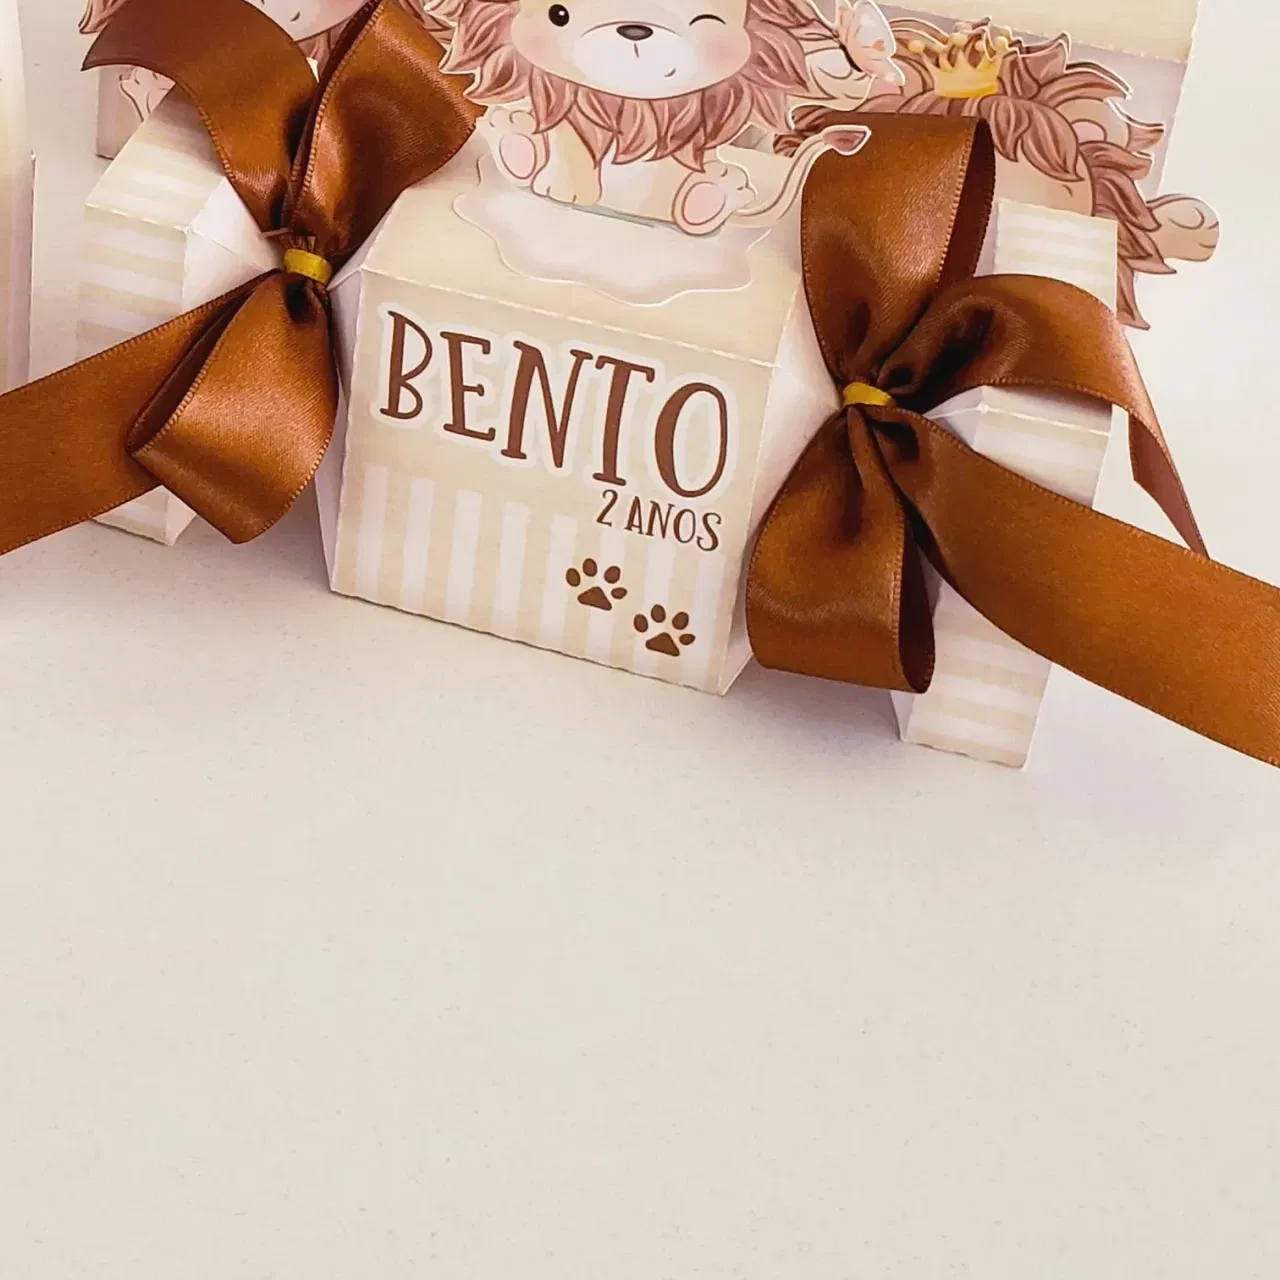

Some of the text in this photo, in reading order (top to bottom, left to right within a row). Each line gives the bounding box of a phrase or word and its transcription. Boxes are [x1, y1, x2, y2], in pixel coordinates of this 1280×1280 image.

[379, 310, 728, 498] BENTO
[595, 489, 723, 553] 2 ANOS
